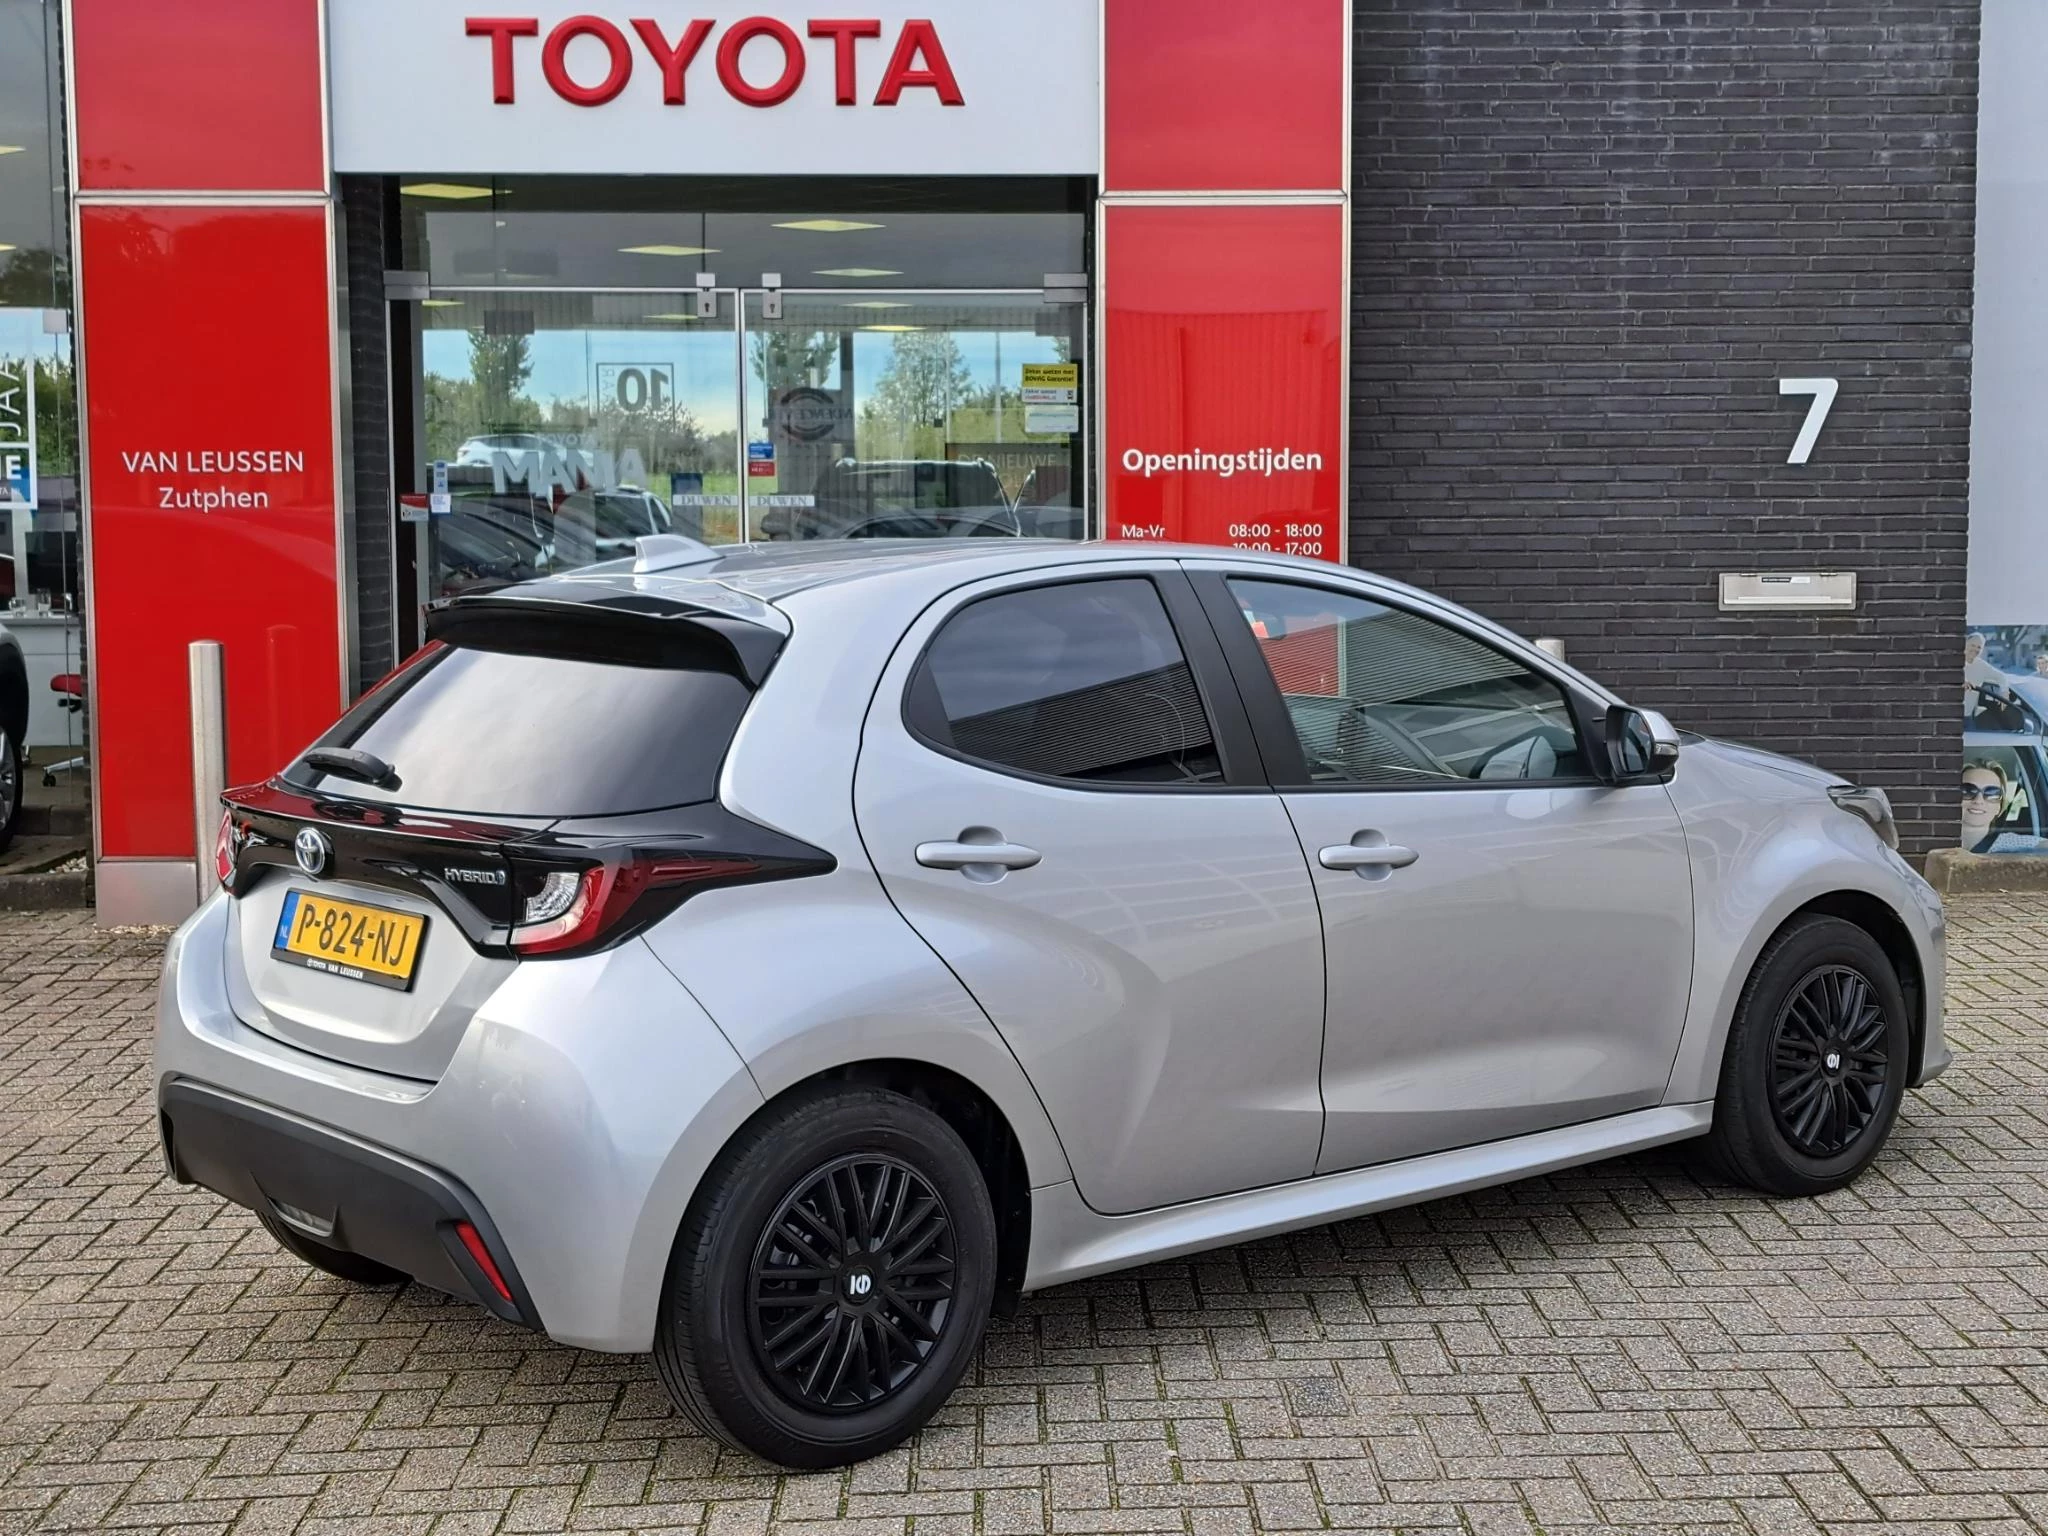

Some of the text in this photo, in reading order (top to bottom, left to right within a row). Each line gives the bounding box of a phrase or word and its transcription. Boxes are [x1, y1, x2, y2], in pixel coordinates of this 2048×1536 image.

[465, 15, 965, 107] TOYOTA
[1779, 378, 1839, 464] 7
[122, 451, 304, 473] VAN LEUSSEN
[1122, 448, 1322, 477] Openingstijden
[492, 449, 647, 498] MANIA
[159, 486, 268, 513] Zutphen
[681, 495, 732, 506] DUWEN
[757, 495, 808, 506] DUWEN
[1121, 525, 1165, 538] Ma-Vr
[1229, 524, 1271, 537] 08:00
[1284, 524, 1322, 537] 18:00
[1284, 542, 1322, 556] 17:00
[444, 867, 497, 885] HYBRID
[280, 926, 289, 938] NL
[295, 903, 410, 967] P-824-NJ
[328, 963, 339, 973] VAN
[339, 966, 364, 980] LEUSSEN
